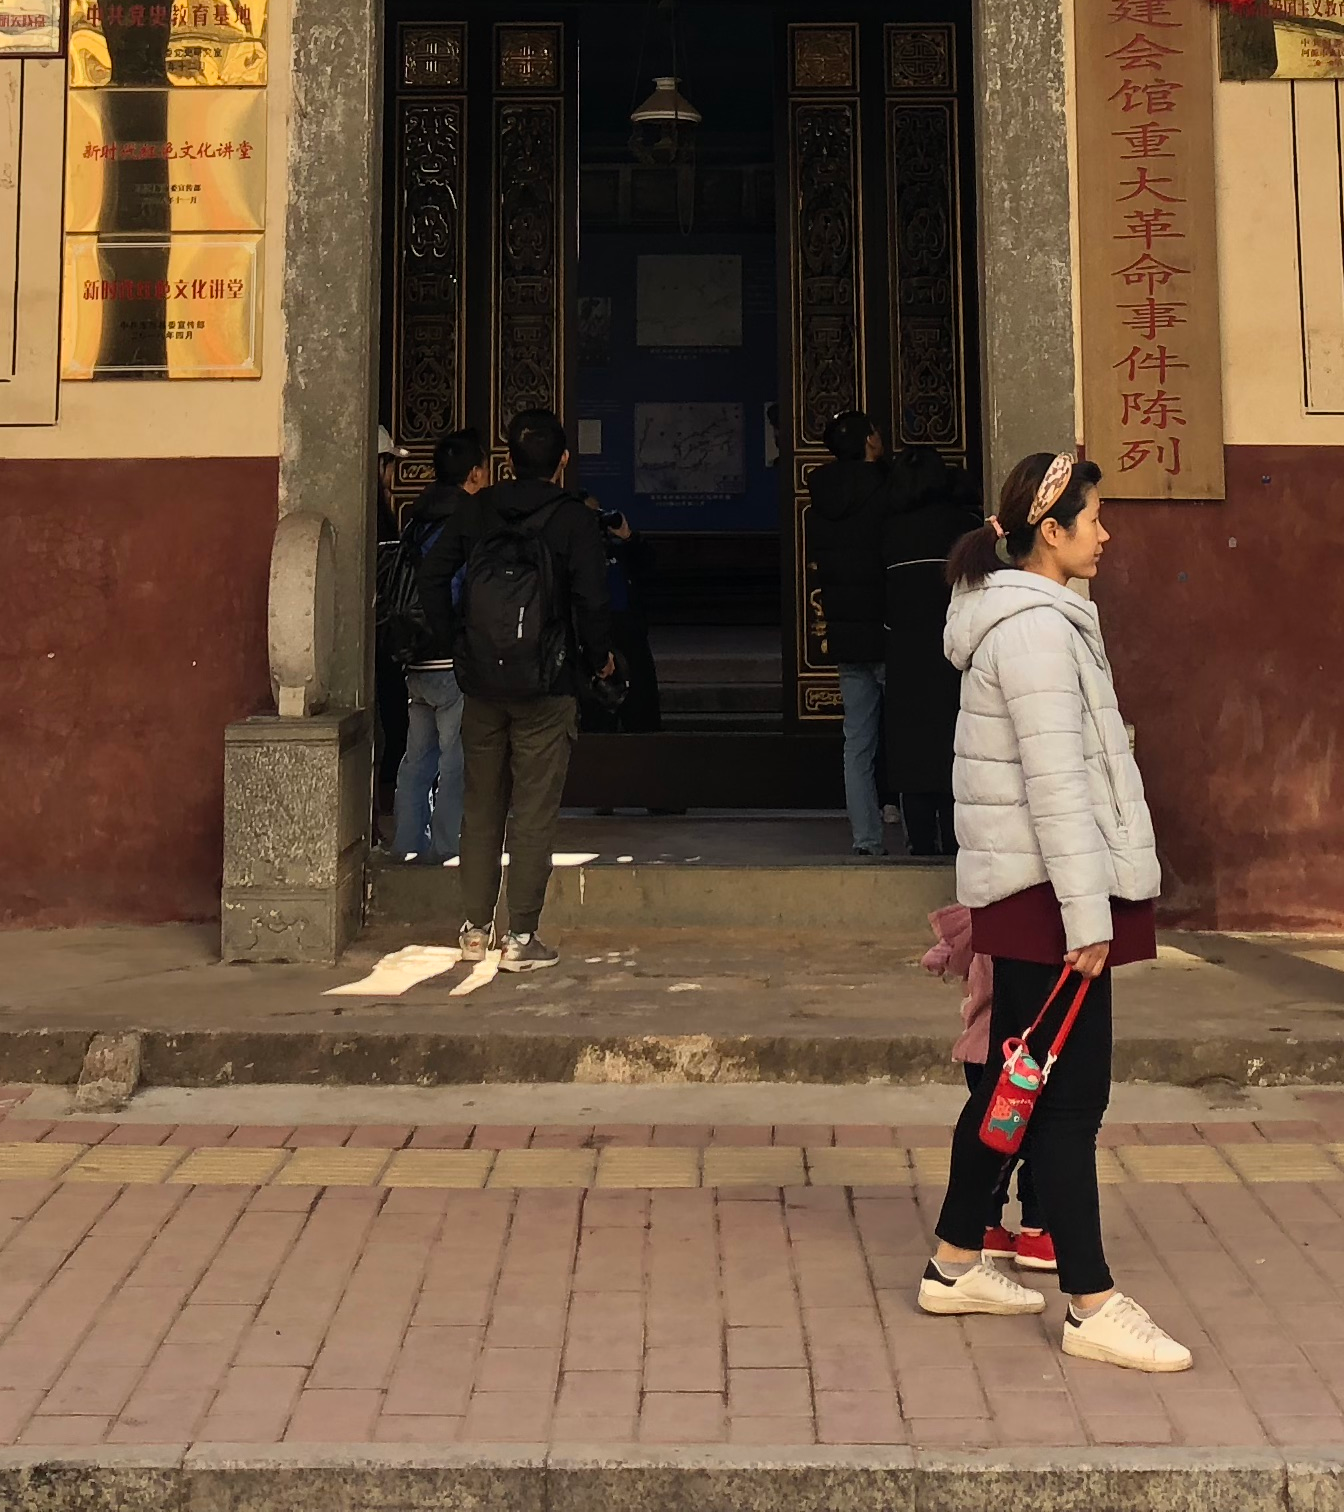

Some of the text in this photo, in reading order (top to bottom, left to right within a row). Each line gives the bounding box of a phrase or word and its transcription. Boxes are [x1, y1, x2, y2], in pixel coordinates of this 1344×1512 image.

[86, 4, 251, 28] 中共党史教育基地
[83, 140, 254, 161] 新时代红色文化讲堂
[83, 279, 244, 300] 新时代红色文化讲堂
